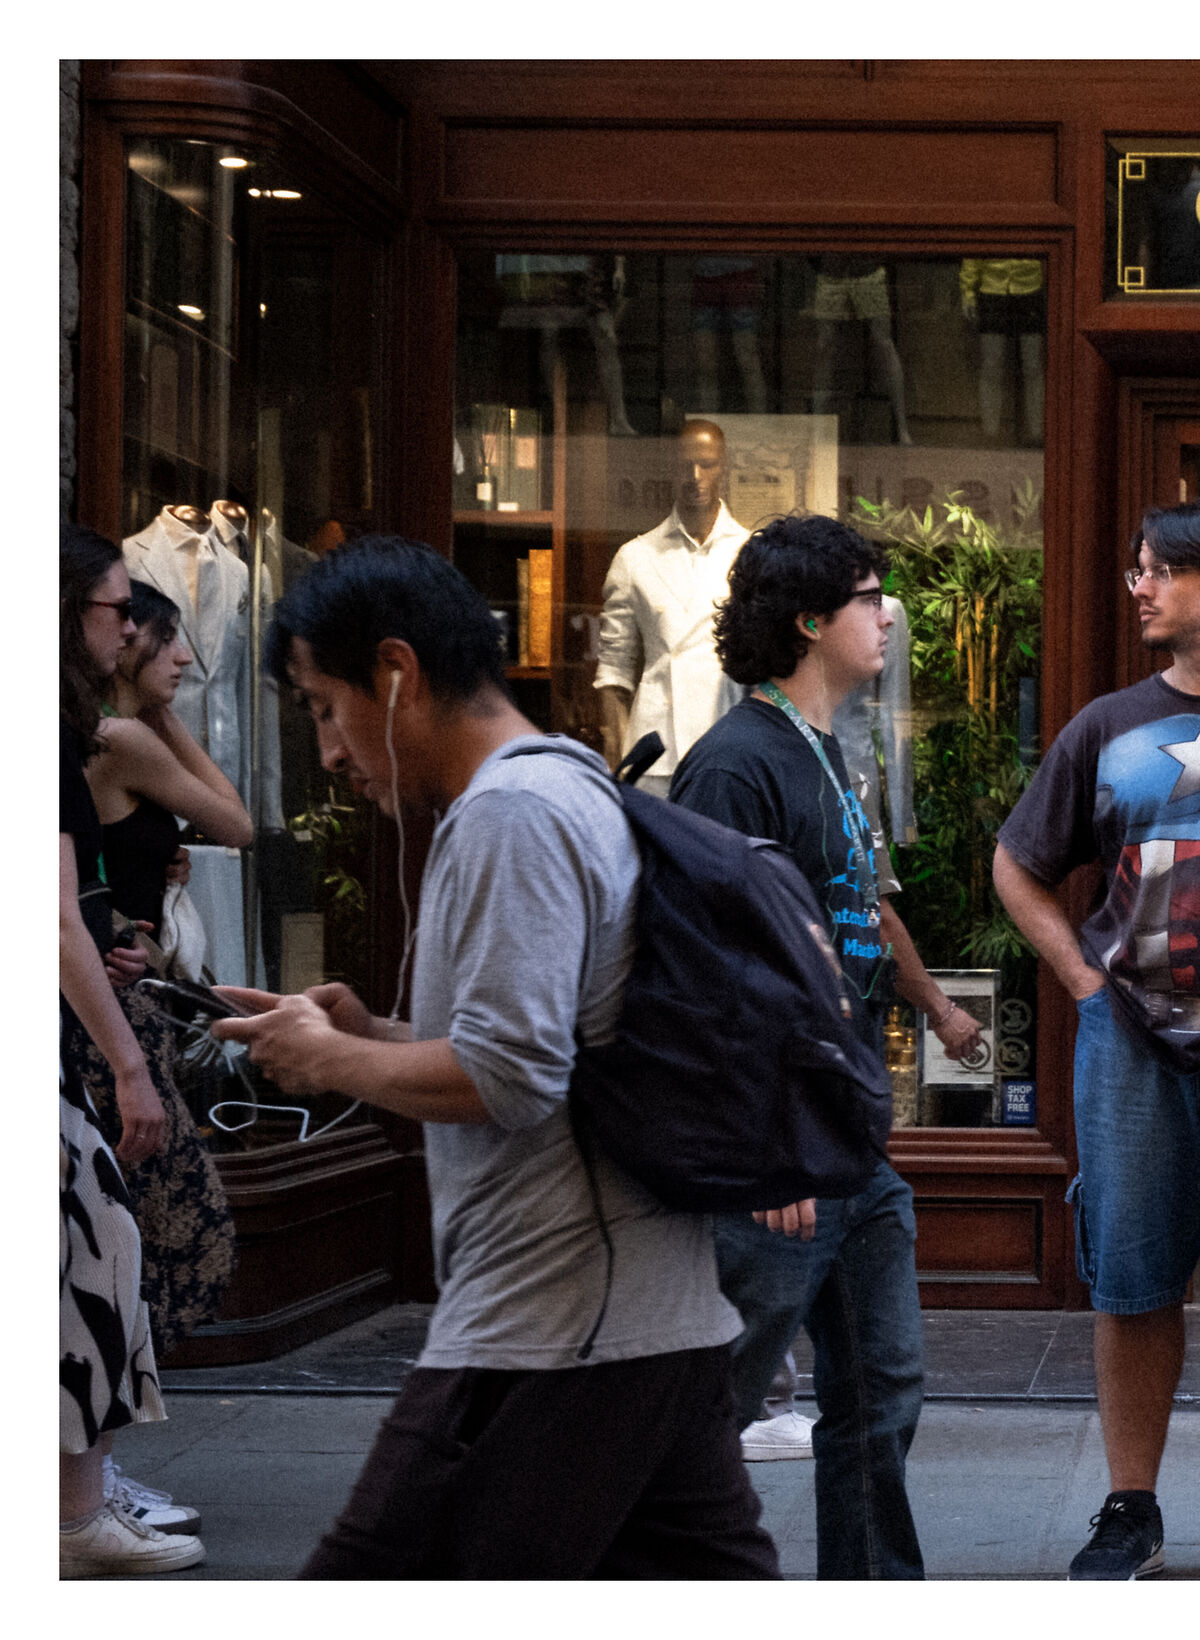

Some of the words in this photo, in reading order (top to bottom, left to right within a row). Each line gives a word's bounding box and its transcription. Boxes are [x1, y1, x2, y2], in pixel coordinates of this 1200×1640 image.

[1007, 1085, 1032, 1094] SHOP
[1007, 1094, 1026, 1103] TAX
[1007, 1103, 1030, 1112] FREE
